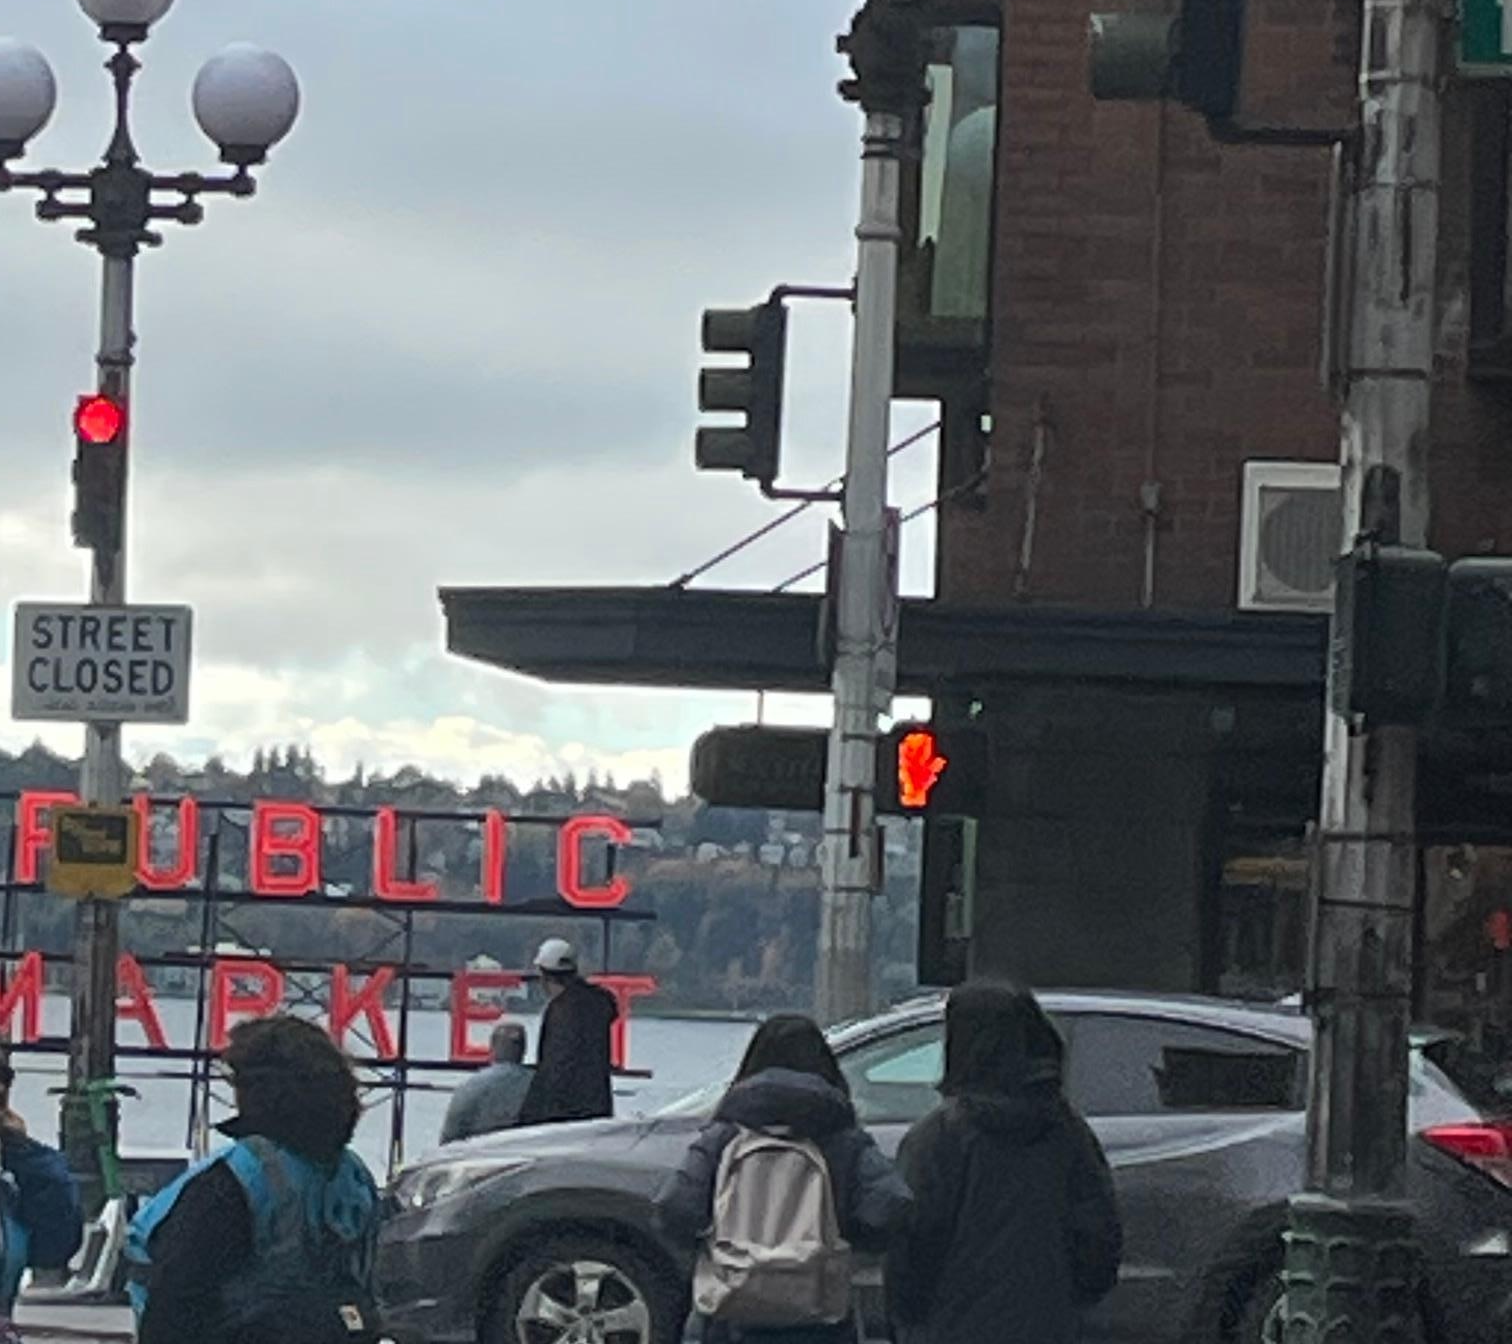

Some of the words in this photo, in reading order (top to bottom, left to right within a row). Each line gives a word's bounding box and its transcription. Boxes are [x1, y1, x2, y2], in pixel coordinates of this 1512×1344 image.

[31, 614, 177, 652] STREET
[27, 656, 175, 696] CLOSED
[13, 789, 634, 909] PUBLIC
